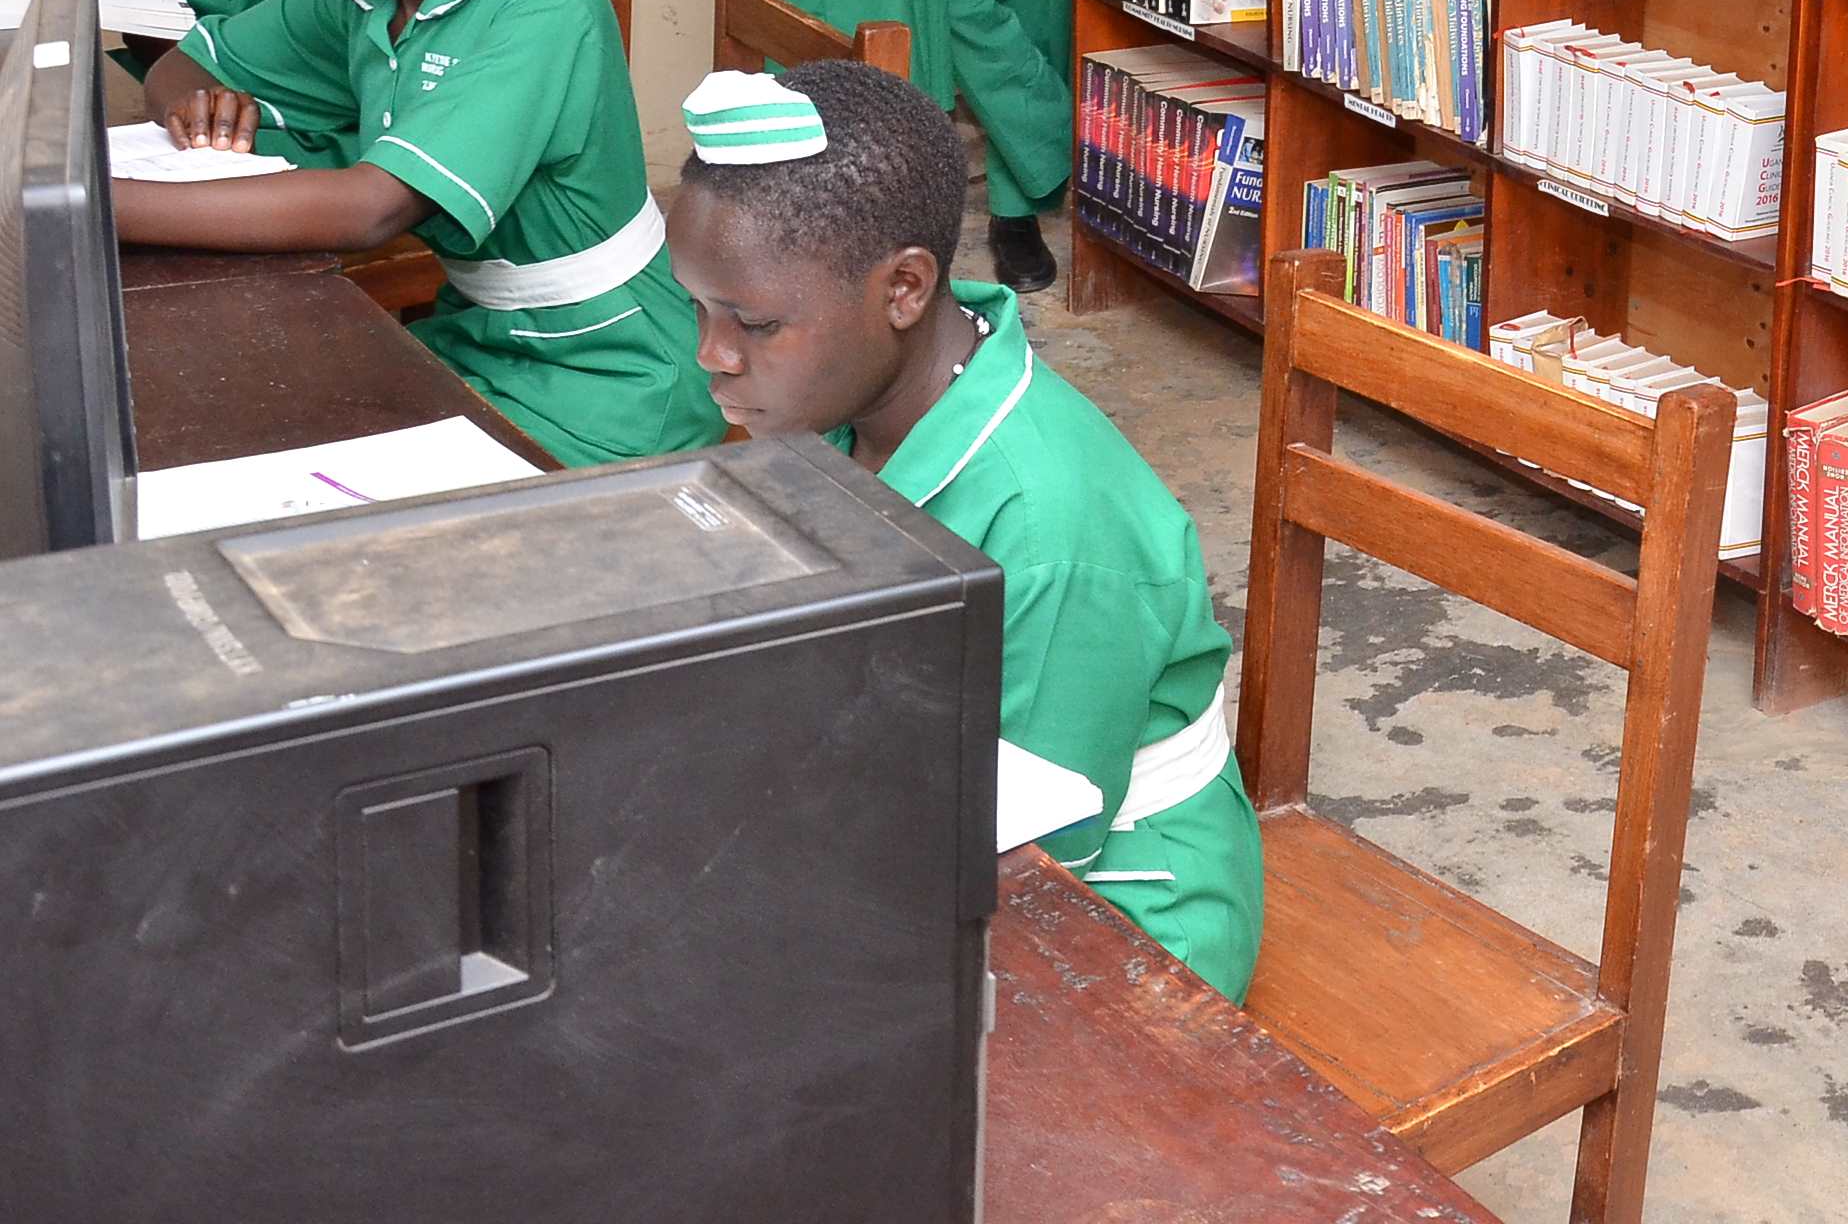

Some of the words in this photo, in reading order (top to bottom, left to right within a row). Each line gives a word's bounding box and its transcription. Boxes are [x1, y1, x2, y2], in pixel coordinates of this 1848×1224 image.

[1460, 11, 1468, 76] FOUNDATIONS
[1156, 101, 1168, 155] Community
[1154, 155, 1164, 187] Health
[1152, 188, 1162, 226] Nursing
[1824, 485, 1840, 561] MANUAL
[1823, 563, 1839, 622] MERCK
